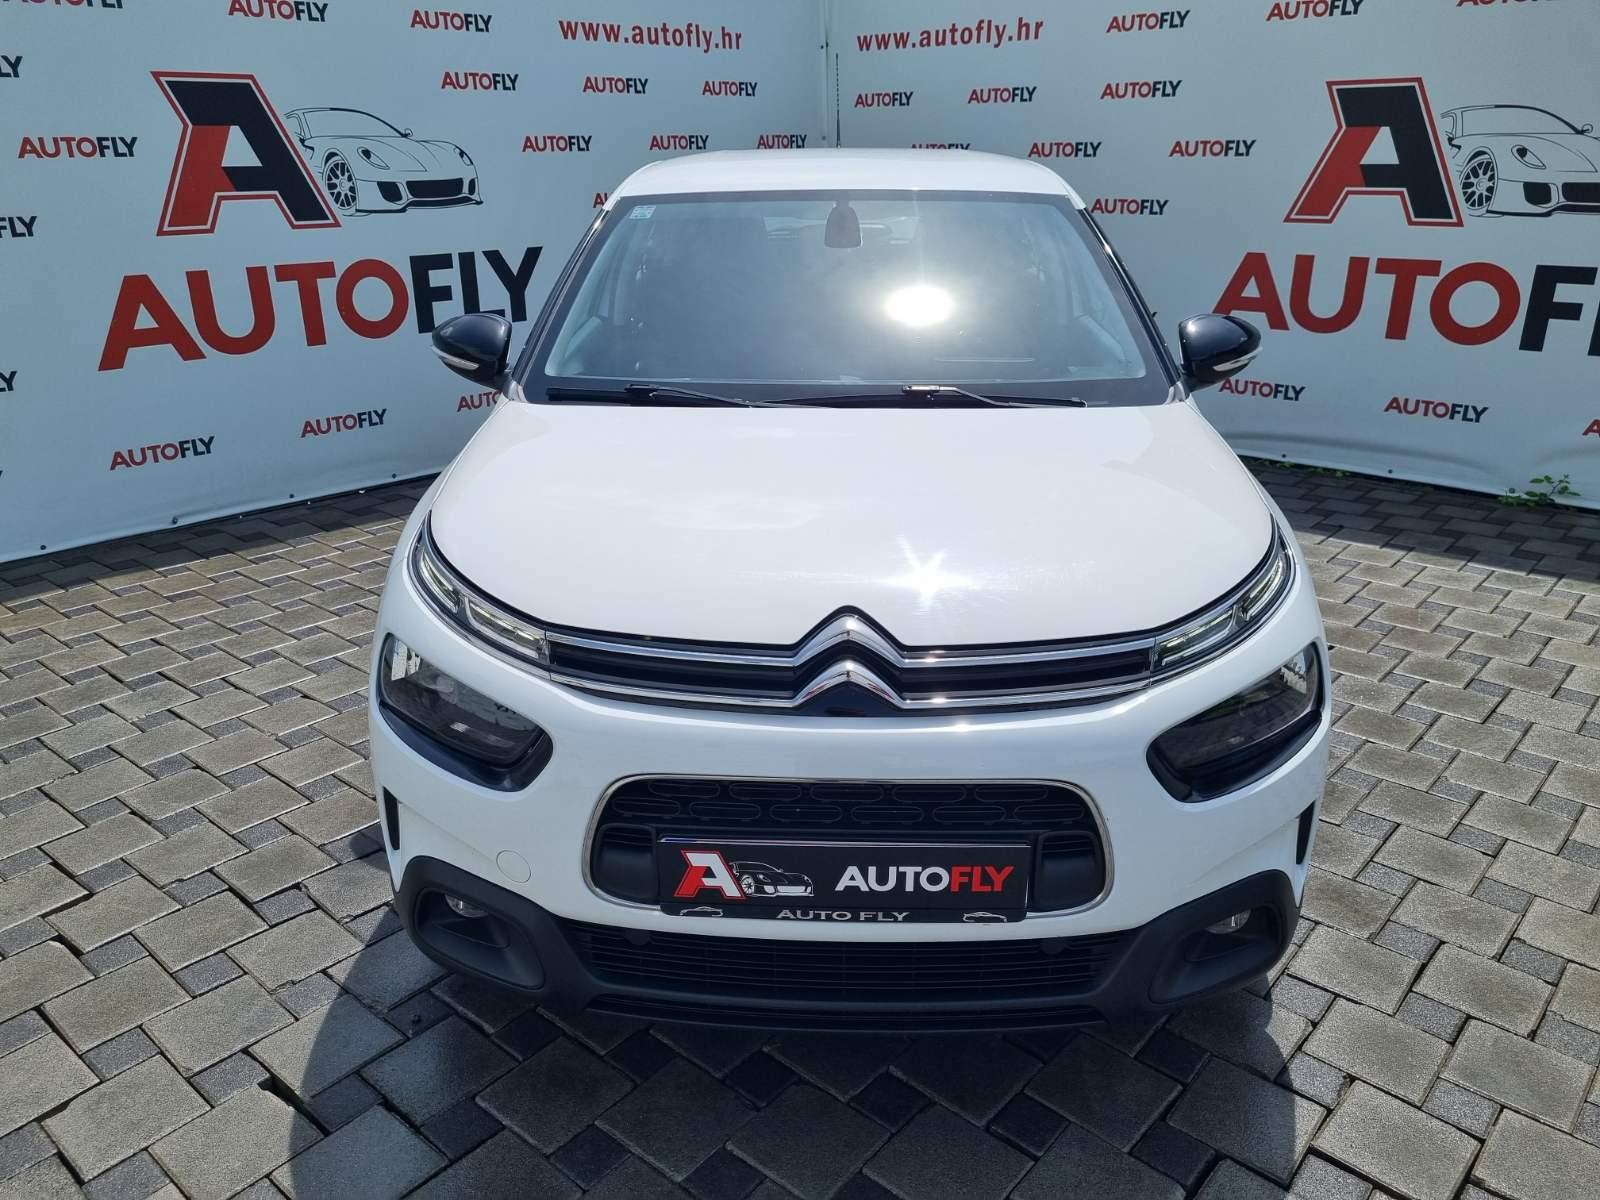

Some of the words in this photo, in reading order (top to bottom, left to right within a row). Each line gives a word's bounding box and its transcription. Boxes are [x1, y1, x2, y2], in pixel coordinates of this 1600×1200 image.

[228, 0, 328, 22] AUTOFLY
[410, 10, 492, 32] AUTOFLY
[1266, 0, 1363, 21] AUTOFLY
[1106, 10, 1190, 33] AUTOFLY
[559, 20, 741, 54] www.autofly.hr
[857, 17, 1043, 52] www.autofly.hr
[441, 72, 519, 91] AUTOFLY
[583, 76, 648, 94] AUTOFLY
[702, 81, 757, 96] AUTOFLY
[1100, 80, 1182, 99] AUTOFLY
[854, 92, 913, 108] AUTOFLY
[968, 86, 1037, 104] AUTOFLY
[18, 137, 137, 159] AUTOFLY
[522, 136, 592, 152] AUTOFLY
[650, 135, 709, 150] AUTOFLY
[757, 134, 807, 149] AUTOFLY
[1028, 142, 1102, 158] AUTOFLY
[1169, 140, 1256, 157] AUTOFLY
[1091, 198, 1169, 216] AUTOFLY
[98, 246, 543, 371] AUTOFLY
[1213, 252, 1600, 356] AUTOF
[1219, 378, 1305, 401] AUTOFLY
[1384, 397, 1488, 423] AUTOFLY
[301, 408, 387, 438] AUTOFLY
[110, 436, 215, 471] AUTOFLY
[835, 866, 1014, 892] AUTOFLY
[776, 909, 852, 921] AUTO
[859, 911, 910, 922] FLY
